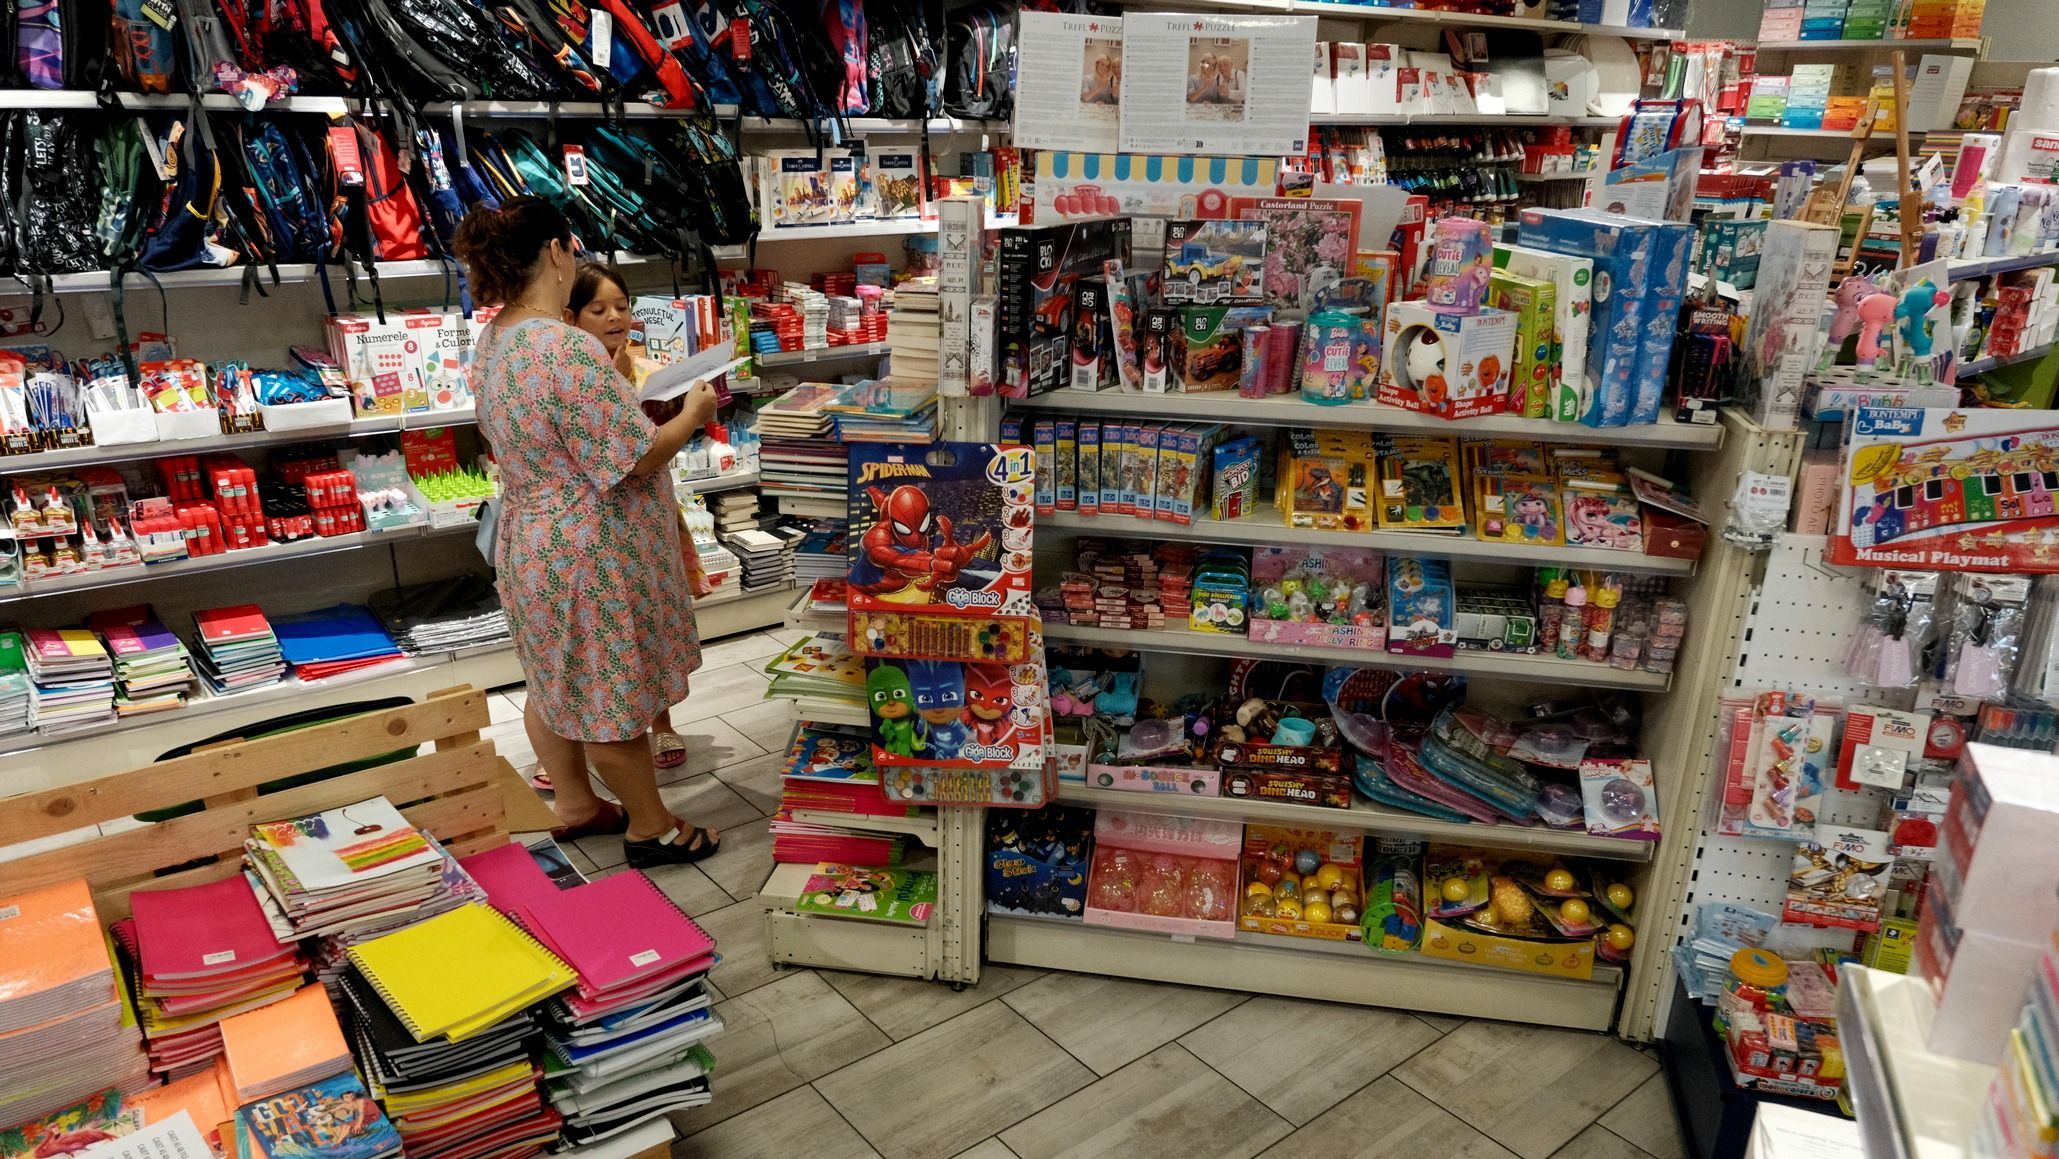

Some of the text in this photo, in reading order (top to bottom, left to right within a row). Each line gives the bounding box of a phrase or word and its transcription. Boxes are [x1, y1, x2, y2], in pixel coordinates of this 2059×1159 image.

[1100, 25, 1122, 33] PUZZ
[1260, 200, 1333, 211] Castorland Puzzle
[1692, 311, 1730, 320] SMOOTH
[644, 316, 665, 326] VESEL
[1693, 318, 1728, 326] WRITING
[356, 331, 409, 345] Numerele
[437, 328, 471, 338] Forme
[407, 342, 414, 350] 8
[442, 337, 475, 348] Culori
[1326, 347, 1349, 356] CUTIE
[1379, 393, 1420, 409] Activity Ball
[1453, 408, 1479, 418] Activity
[994, 451, 1032, 481] 4 in 1
[856, 462, 932, 484] SPIDER-MAN
[1230, 471, 1249, 489] BID
[2001, 499, 2020, 509] Sol
[1855, 549, 2010, 567] Musical Playmat
[948, 590, 1000, 606] Giga Block
[1349, 638, 1374, 647] RING
[1931, 699, 1965, 709] FIMO
[1883, 724, 1916, 735] FIMO
[964, 745, 1013, 761] Giga Block
[1257, 748, 1294, 756] SQUISHY
[1267, 780, 1306, 788] SQUISHY
[1833, 842, 1865, 853] FIMO
[1315, 928, 1343, 938] DUCK
